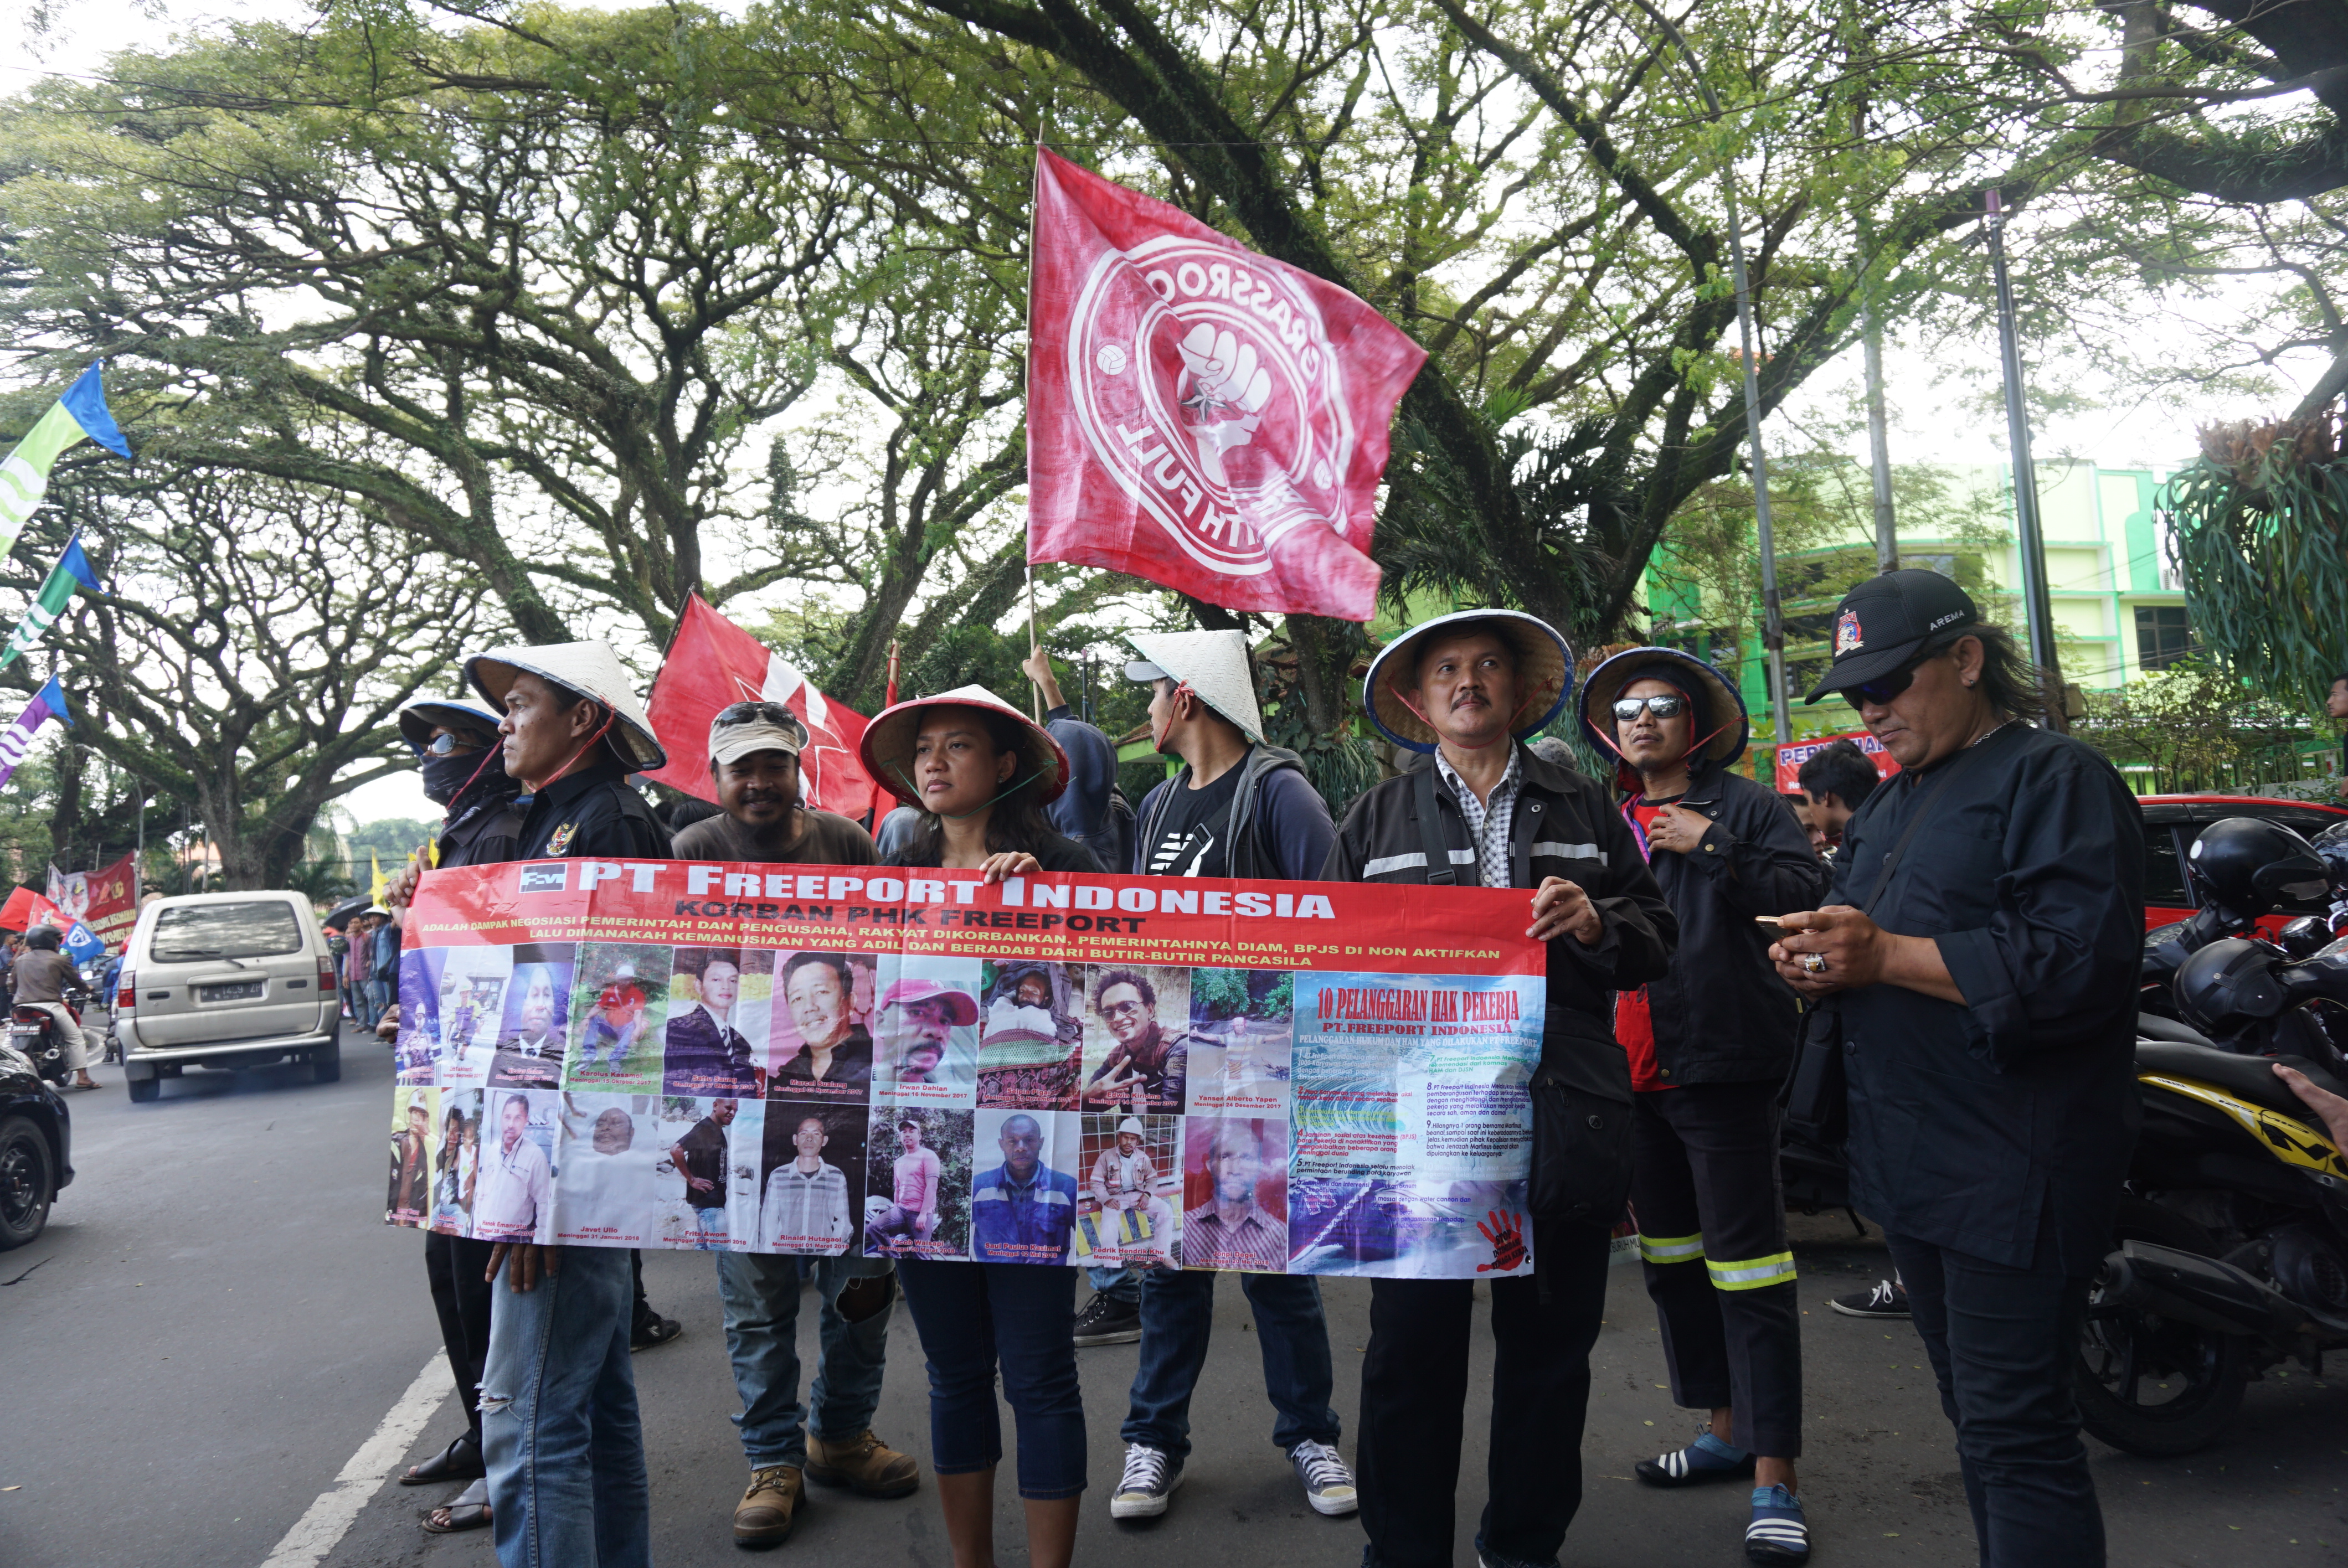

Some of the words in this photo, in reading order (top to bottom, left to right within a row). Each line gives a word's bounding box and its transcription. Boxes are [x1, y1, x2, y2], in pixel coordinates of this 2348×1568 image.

[1929, 610, 1965, 631] AREMA
[579, 862, 667, 893] PT
[688, 865, 983, 904] FREEPORT
[1002, 877, 1336, 919] INDONESIA
[675, 901, 833, 922] KORBAN
[848, 907, 929, 925] PHK
[942, 910, 1146, 933] FREEPORT
[422, 922, 468, 932] ADALAH
[471, 920, 507, 930] DAMPAK
[511, 916, 576, 927] NEGOSIASI
[582, 916, 691, 929] PEMERINTAH
[697, 921, 733, 930] DAN
[739, 923, 853, 937] PENGUSAHA,
[858, 927, 928, 939] RAKYAT
[934, 930, 1071, 945] DIKORBANKAN,
[1078, 936, 1231, 951] PEMERINTAHNYA
[1238, 942, 1288, 954] DIAM,
[1294, 945, 1339, 953] BPJS
[1368, 947, 1406, 956] NON
[1412, 948, 1500, 958] AKTIFKAN
[530, 930, 563, 938] LALU
[567, 929, 666, 940] DIMANAKAH
[672, 932, 805, 946] KEMANUSIAAN
[809, 938, 856, 948] YANG
[862, 940, 903, 950] ADIL
[909, 942, 944, 951] DAN
[951, 943, 1036, 955] BERADAB
[1042, 948, 1083, 957] DARI
[1090, 949, 1206, 962] BUTIR-BUTIR
[1215, 954, 1312, 966] PANCASILA
[1317, 987, 1333, 1019] 10
[1337, 988, 1428, 1022] PELANGGARAN
[1431, 991, 1458, 1022] HAK
[1462, 991, 1519, 1024] PEKERJA
[1299, 1034, 1356, 1044] PELANGGARAN
[1385, 1037, 1400, 1046] DAN
[1402, 1037, 1419, 1046] HAM
[1420, 1038, 1441, 1046] YANG
[1443, 1036, 1487, 1046] DILAKUKAN
[1322, 1023, 1426, 1035] PT.FREEPORT
[1431, 1024, 1512, 1036] INDONESIA
[2158, 1077, 2187, 1088] YAMAHA
